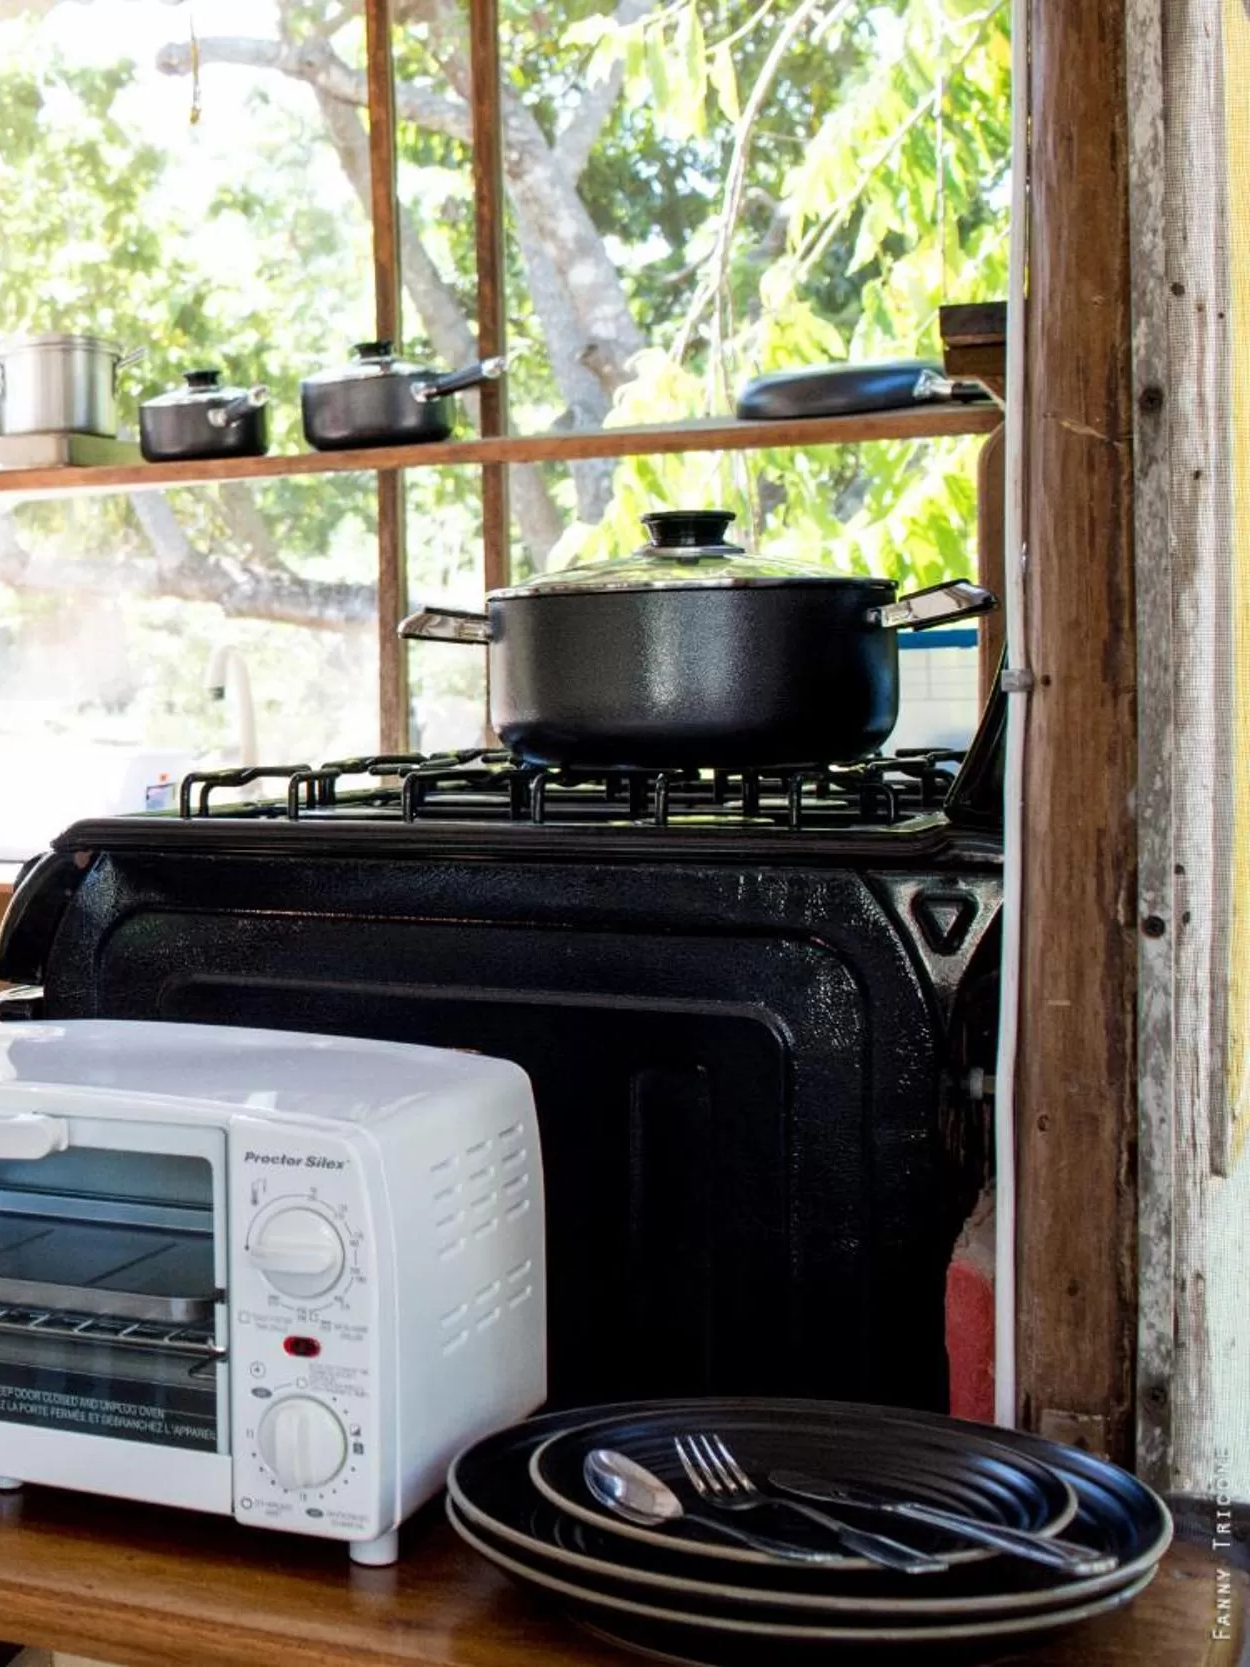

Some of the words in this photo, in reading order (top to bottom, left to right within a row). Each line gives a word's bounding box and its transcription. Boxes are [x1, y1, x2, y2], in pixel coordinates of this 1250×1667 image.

[243, 1151, 304, 1167] Proctor
[304, 1156, 345, 1170] Silex
[15, 1386, 41, 1402] DOOR
[42, 1390, 78, 1406] CLOSED
[138, 1404, 165, 1419] OVEN
